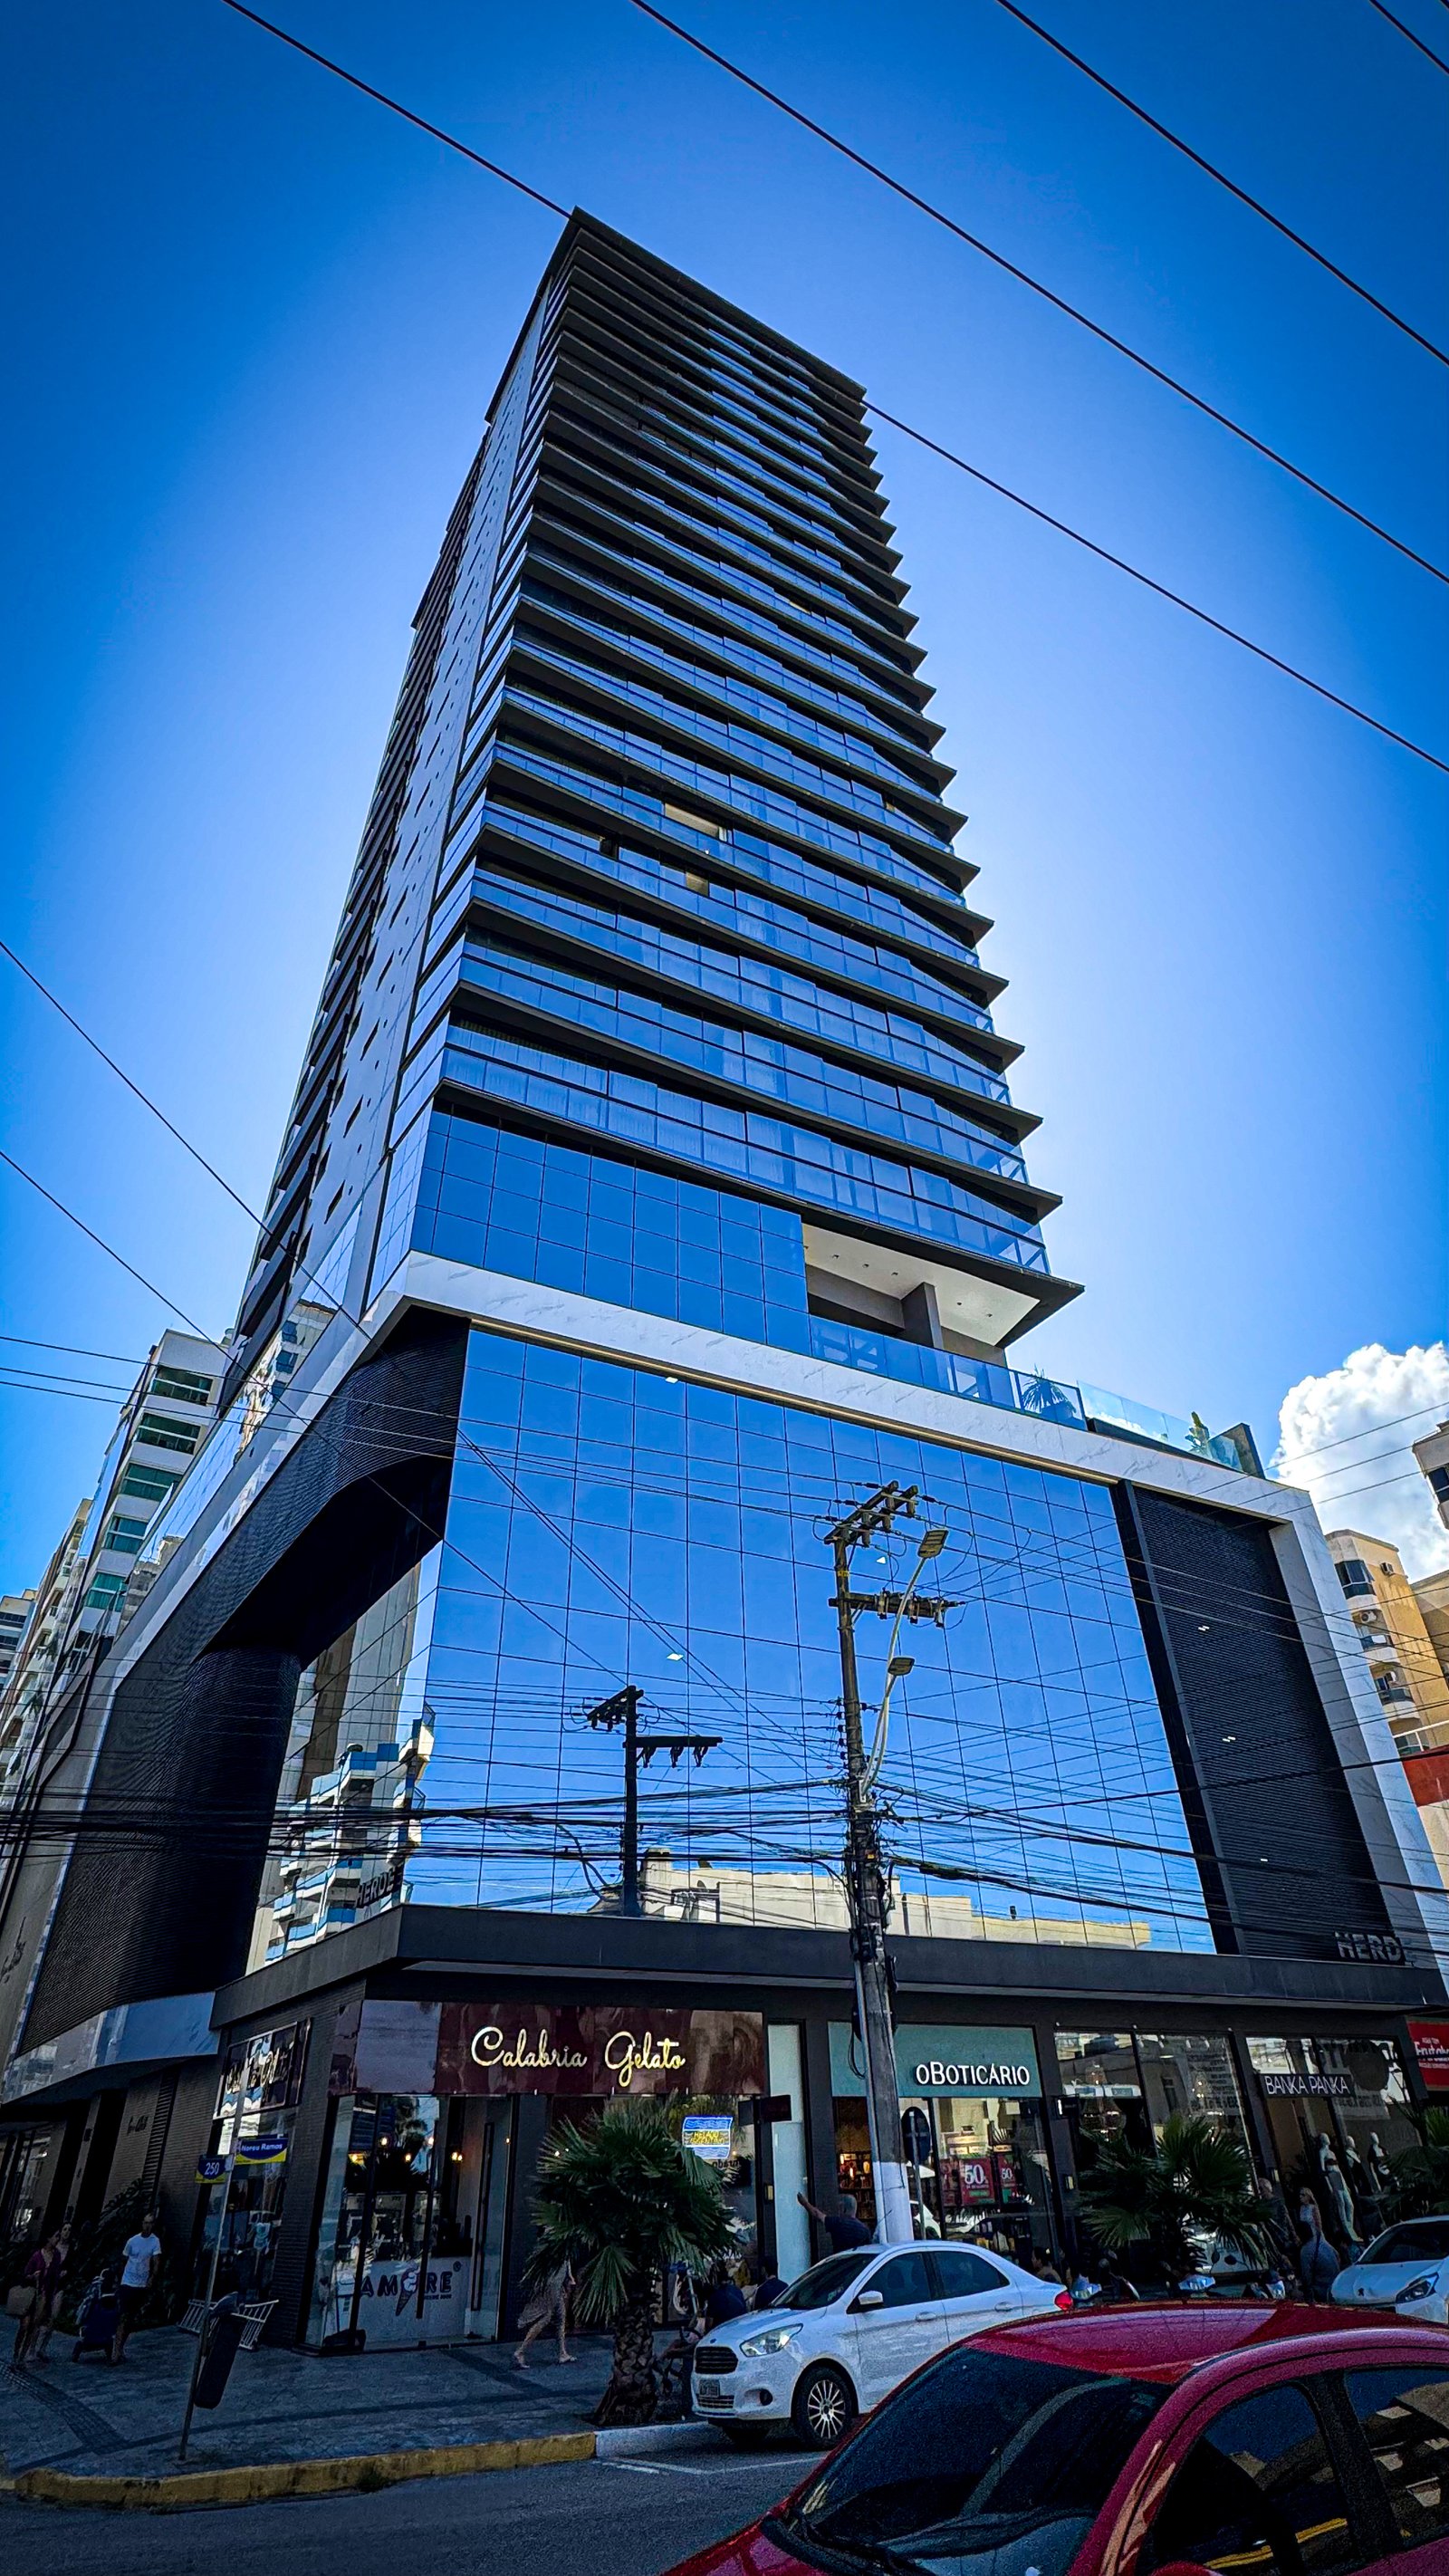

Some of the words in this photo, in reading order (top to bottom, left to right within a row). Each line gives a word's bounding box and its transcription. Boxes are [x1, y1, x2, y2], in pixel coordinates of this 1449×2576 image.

[471, 2026, 588, 2067] Calabria
[605, 2031, 686, 2087] Gelato
[1264, 2075, 1310, 2094] BANKA
[1309, 2076, 1350, 2094] PANKA
[261, 2142, 283, 2150] Ramos
[205, 2161, 220, 2176] 250
